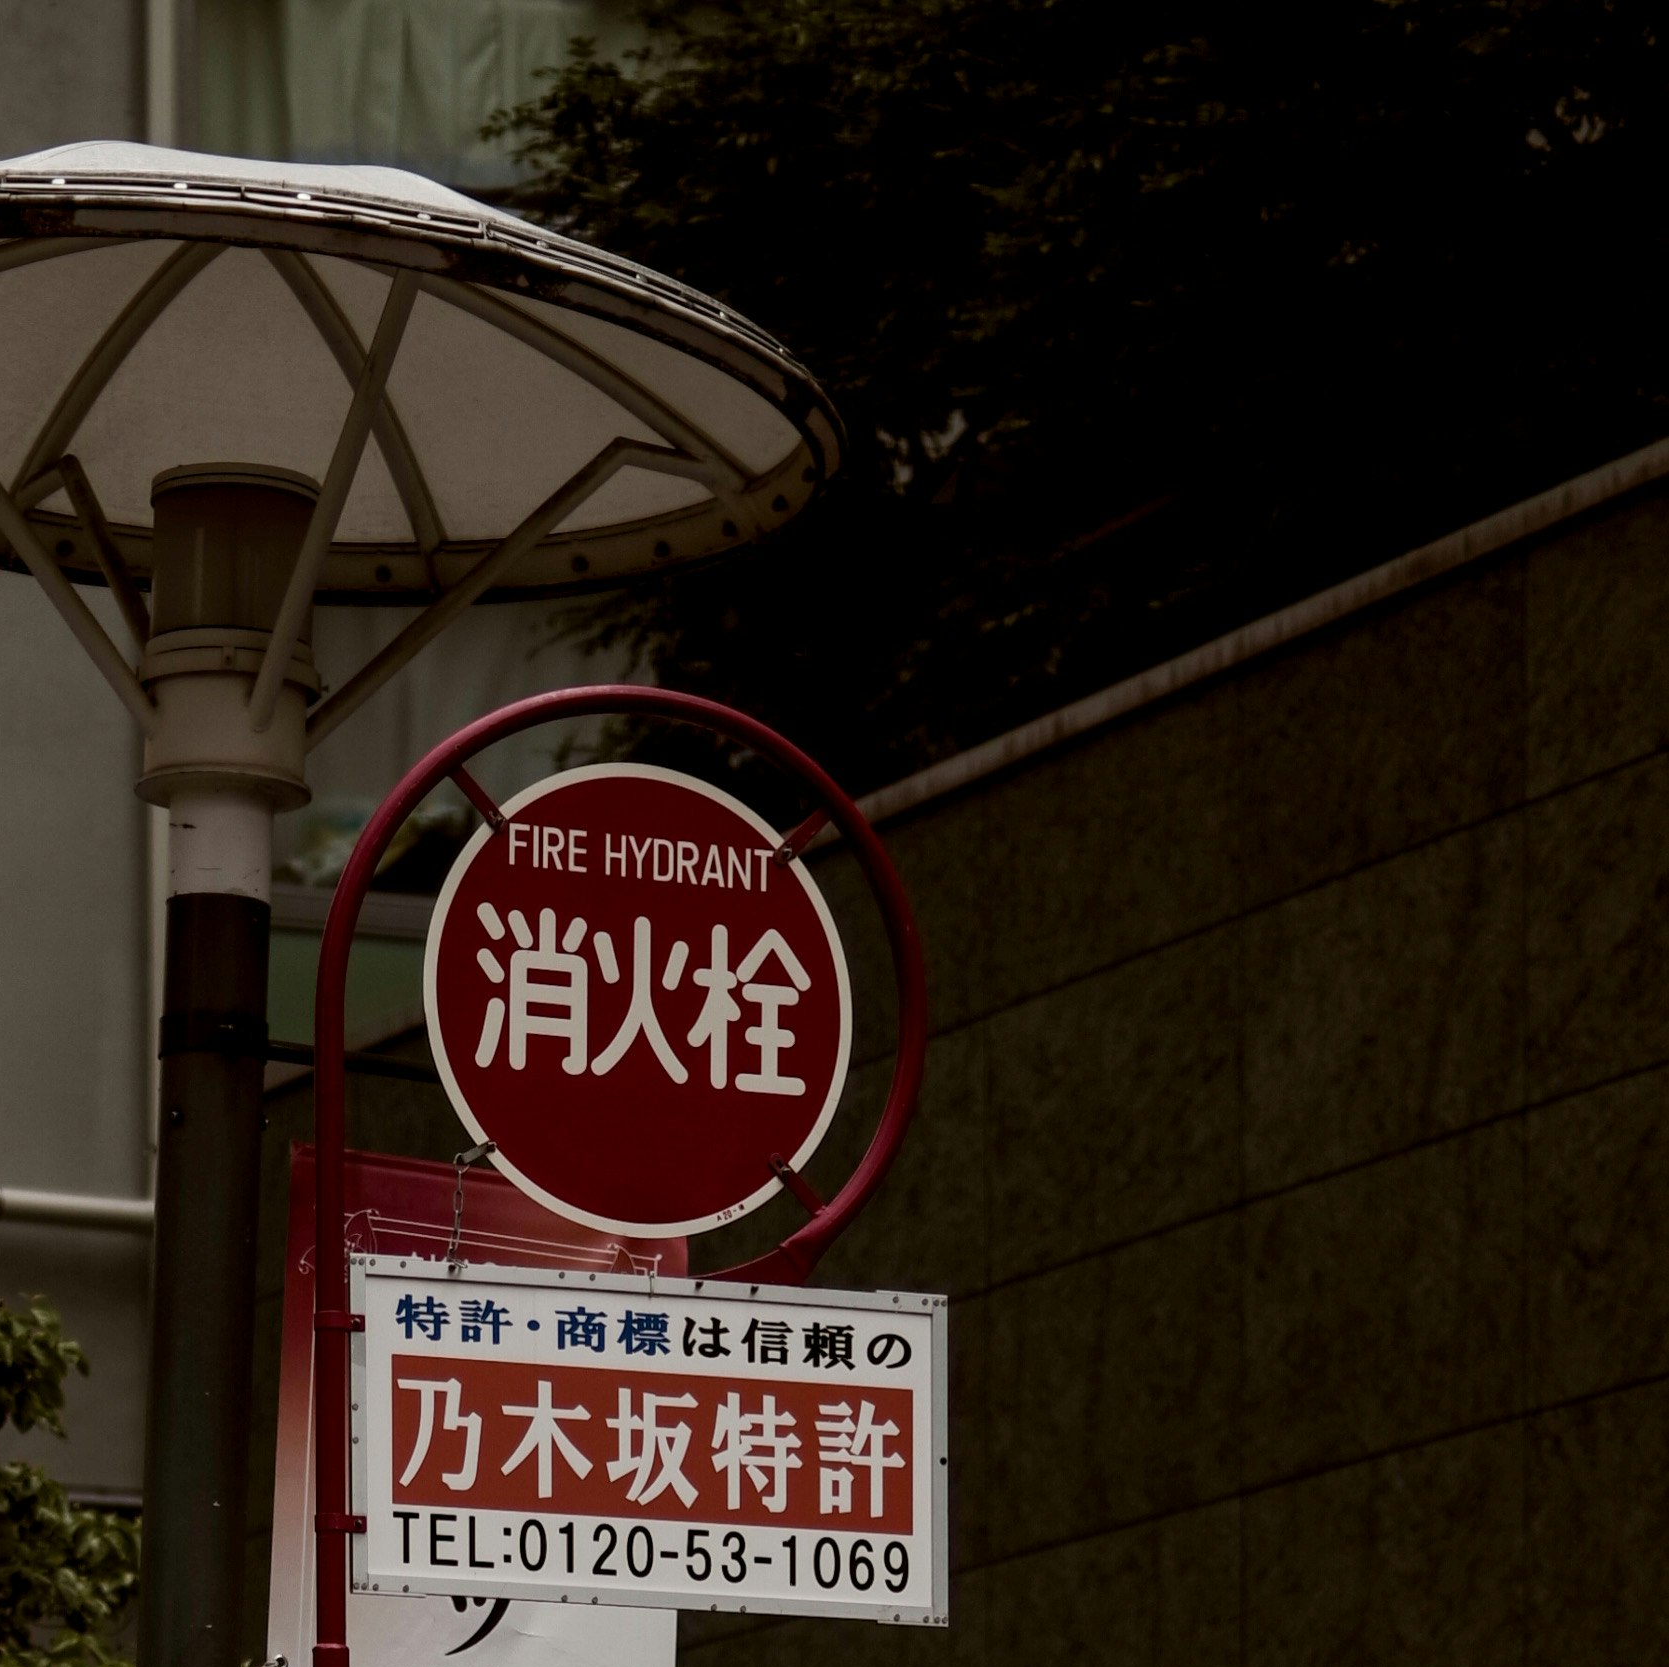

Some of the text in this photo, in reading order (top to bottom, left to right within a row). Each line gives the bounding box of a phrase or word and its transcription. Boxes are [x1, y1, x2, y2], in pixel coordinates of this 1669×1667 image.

[508, 822, 775, 892] FIRE HYDRANT
[474, 902, 813, 1097] 消火栓
[395, 1294, 912, 1372] 特許・商標は信頼の
[397, 1377, 906, 1518] 乃木坂特許
[392, 1510, 910, 1595] TEL:0120-53-1069
